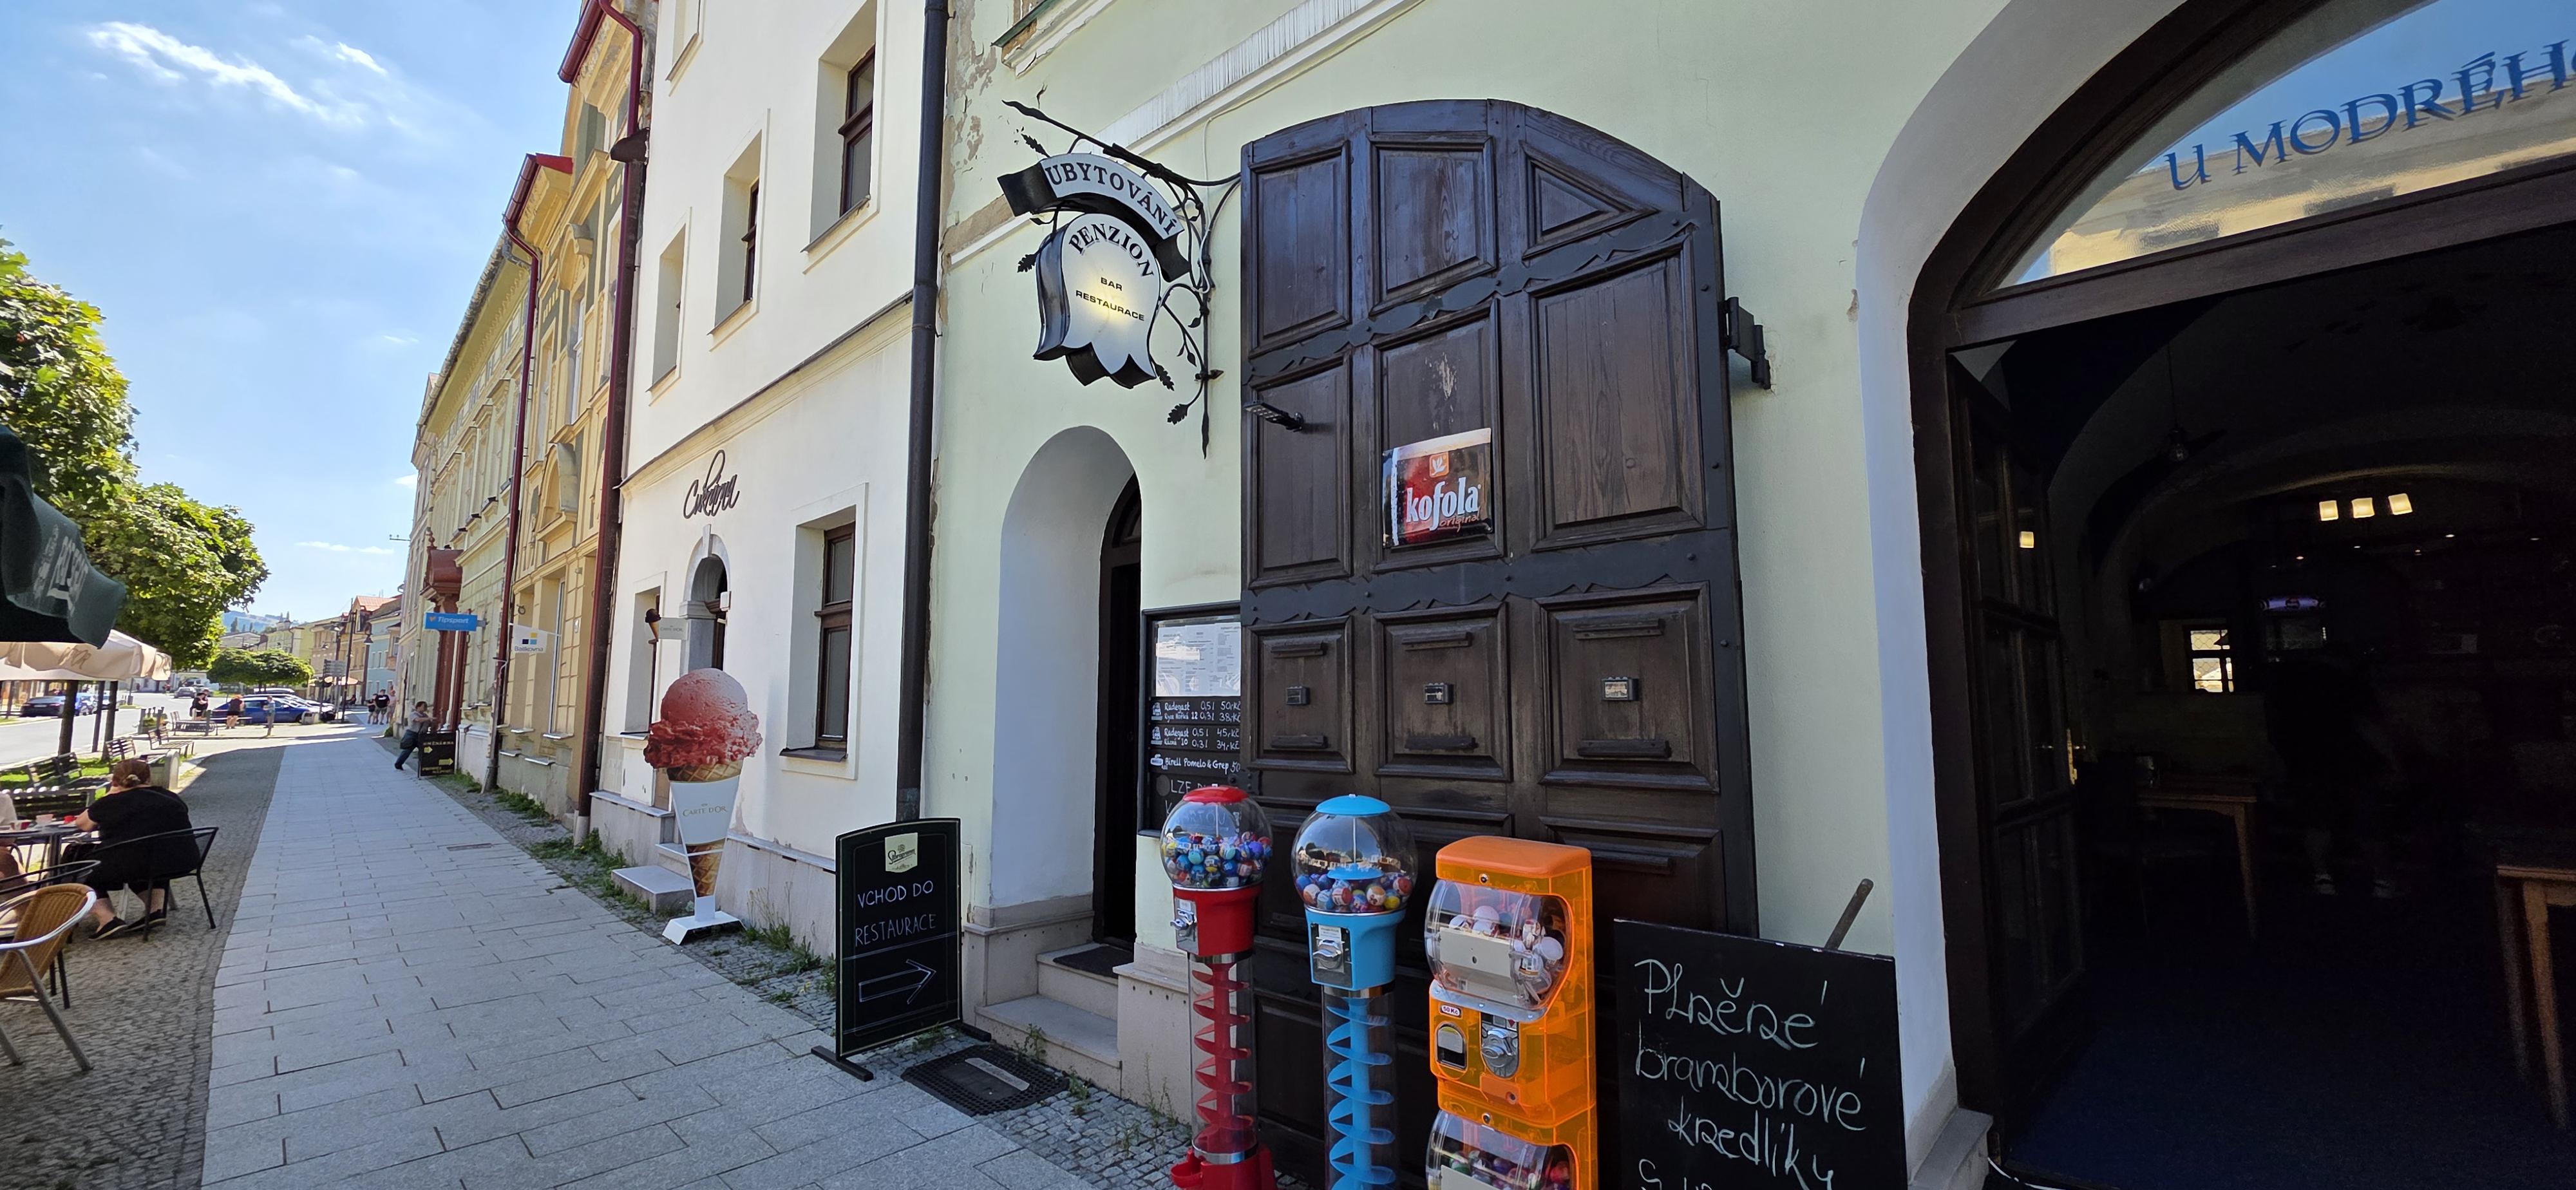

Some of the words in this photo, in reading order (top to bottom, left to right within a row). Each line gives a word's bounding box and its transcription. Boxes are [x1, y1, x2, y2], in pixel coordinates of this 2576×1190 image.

[2164, 144, 2211, 191] U
[2229, 39, 2576, 175] MODRÉH
[1045, 162, 1177, 236] UBYTOVÁNÍ
[1068, 223, 1154, 277] PENZION
[1101, 277, 1123, 291] BAR
[1075, 290, 1144, 321] RESTAURACE
[1406, 477, 1480, 531] kofola
[1439, 506, 1481, 533] original
[1191, 711, 1198, 720] 12
[1181, 738, 1188, 746] 10
[1165, 757, 1181, 766] Birell
[1184, 757, 1206, 768] Pomelo
[1212, 760, 1229, 775] Grep
[683, 809, 707, 817] CARTE
[858, 885, 906, 909] VCHOD
[913, 880, 933, 897] DO
[855, 914, 936, 947] RESTAURACE
[1635, 1019, 1866, 1131] bramborové
